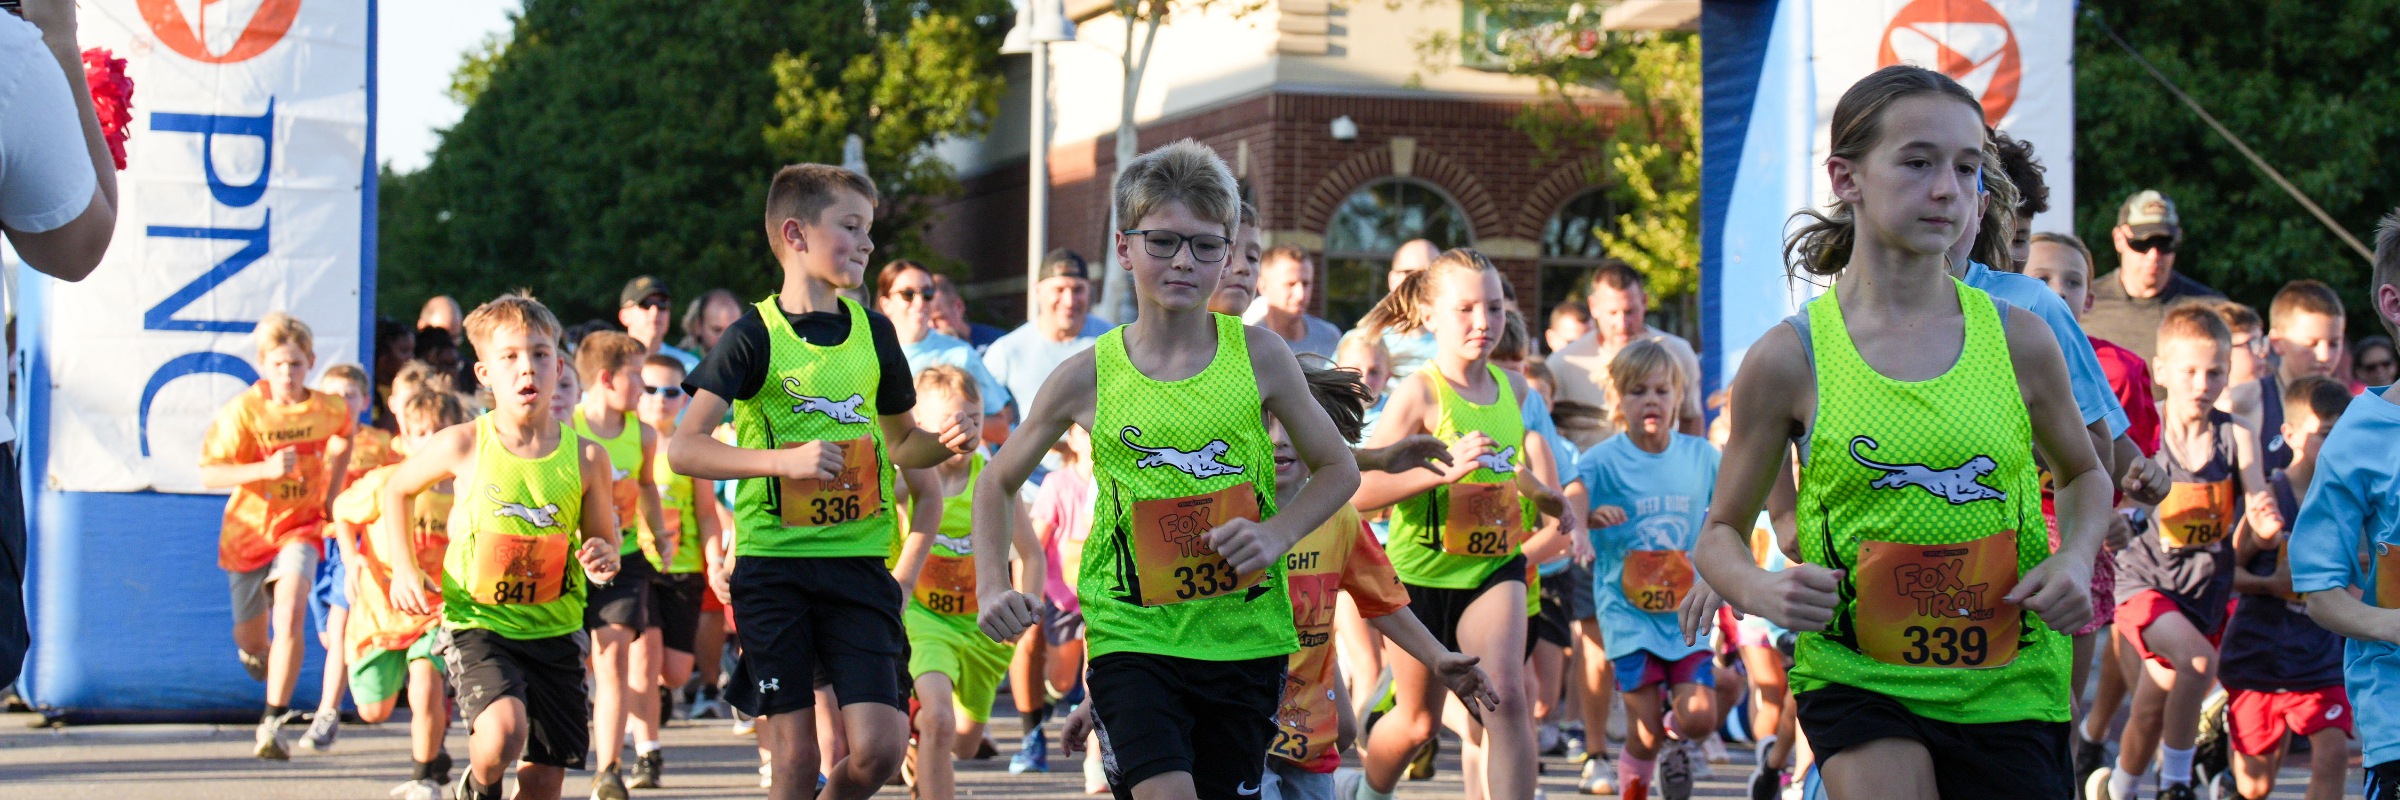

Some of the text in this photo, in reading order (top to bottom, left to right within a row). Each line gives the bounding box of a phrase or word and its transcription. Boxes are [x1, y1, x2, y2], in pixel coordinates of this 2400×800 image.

[138, 94, 275, 458] PNC
[810, 494, 860, 526] 336
[1158, 506, 1215, 543] FOX
[1467, 529, 1509, 555] 824
[2183, 521, 2222, 545] 784
[1286, 551, 1320, 571] GHT
[493, 581, 537, 604] 841
[1174, 558, 1239, 600] 333
[1894, 558, 1965, 596] FOX
[928, 592, 965, 614] 881
[1641, 589, 1676, 611] 250
[1910, 582, 1989, 619] TROT
[1902, 625, 1988, 666] 339
[1279, 707, 1312, 728] ROT
[1272, 729, 1309, 760] 23
